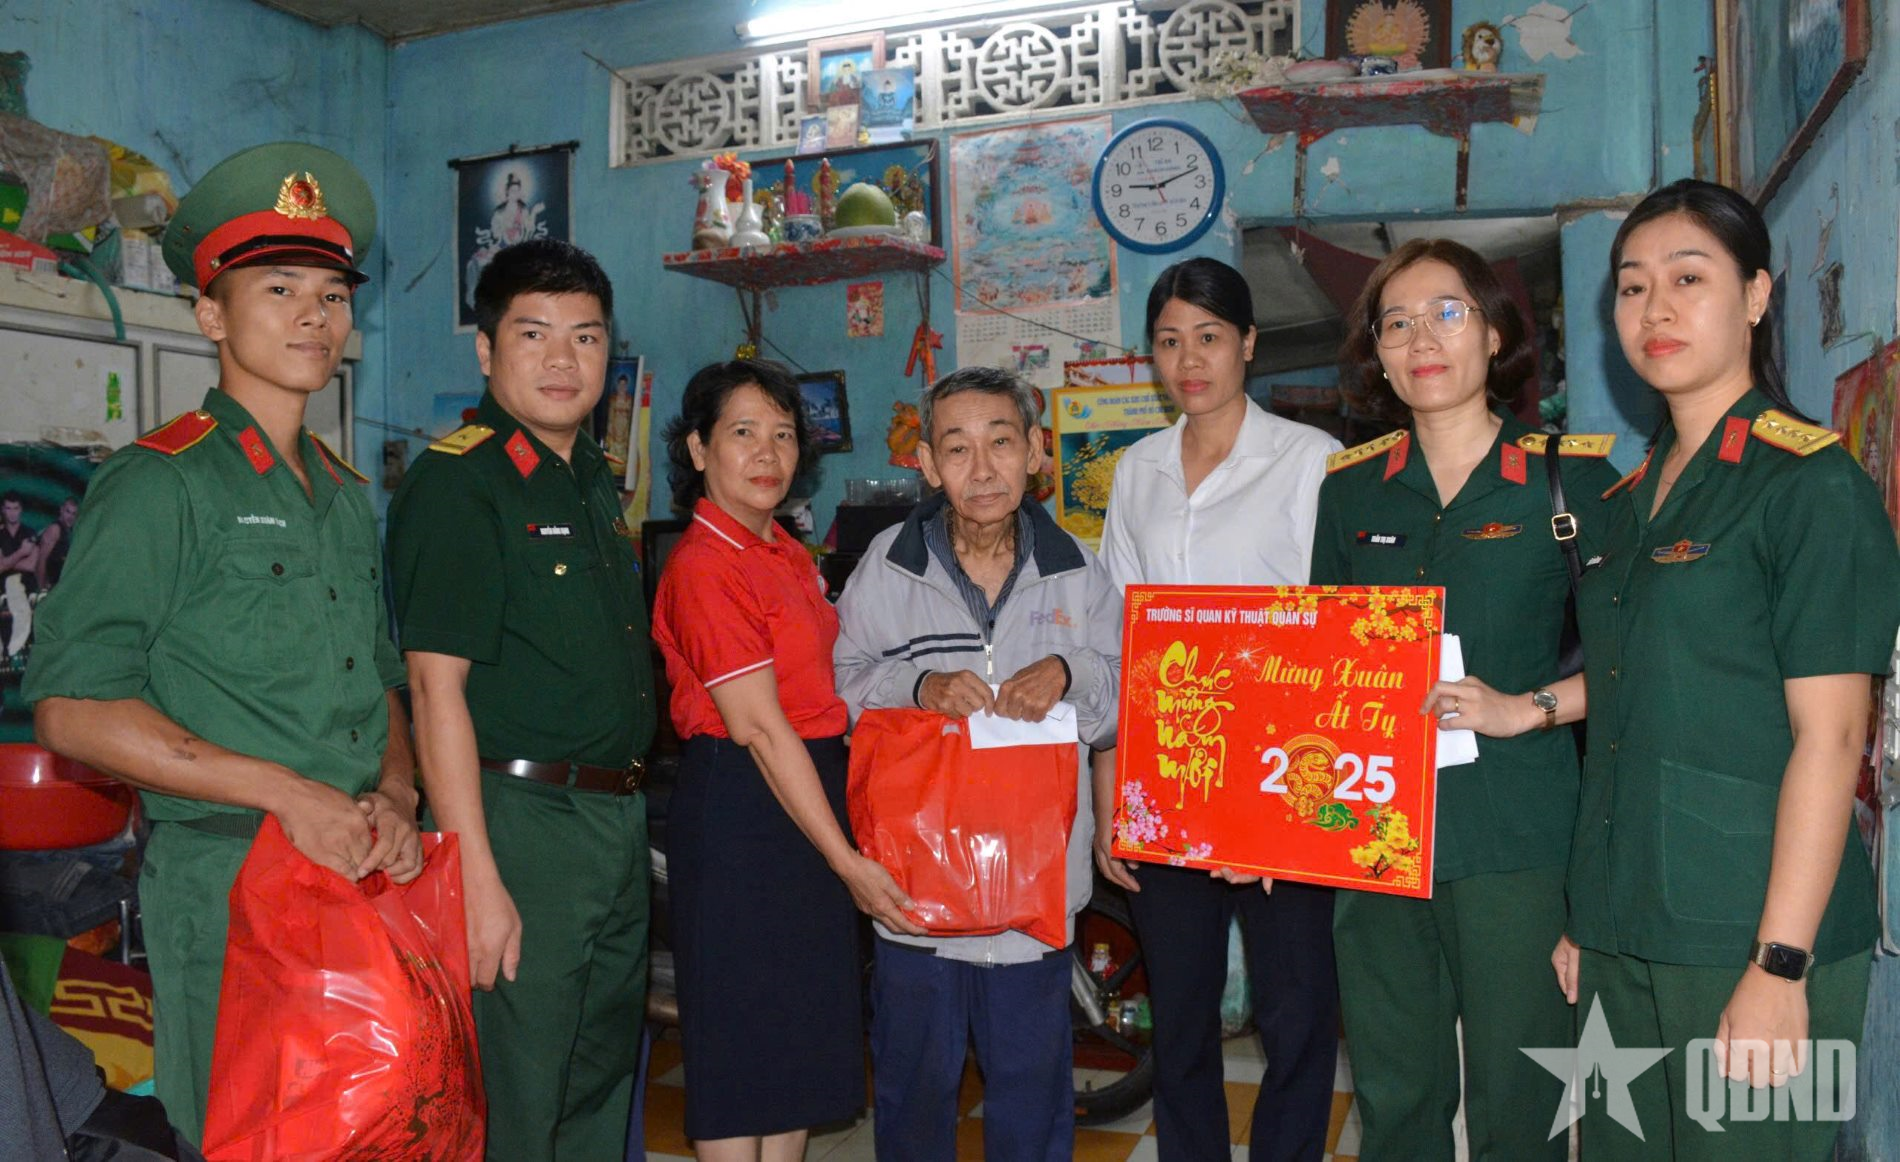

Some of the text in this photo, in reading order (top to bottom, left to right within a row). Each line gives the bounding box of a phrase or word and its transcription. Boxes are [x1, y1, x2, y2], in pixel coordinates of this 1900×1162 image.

[1148, 137, 1163, 151] 12
[1174, 141, 1180, 154] 1
[1131, 145, 1142, 160] 11
[1115, 161, 1131, 176] 10
[1186, 154, 1198, 169] 2
[1194, 174, 1206, 189] 3
[1111, 184, 1122, 198] 9
[1119, 204, 1131, 218] 8
[1189, 197, 1200, 211] 4
[1134, 218, 1145, 231] 7
[1176, 213, 1187, 227] 5
[1155, 221, 1167, 236] 6
[1030, 608, 1073, 627] FedEx
[1146, 606, 1318, 628] TRƯỜNG SĨ QUAN KỸ THUẬT QUÂN SỰ
[1159, 640, 1234, 690] Chúc
[1254, 655, 1404, 692] Mừng Xuân
[1315, 690, 1397, 739] Ất Tỵ
